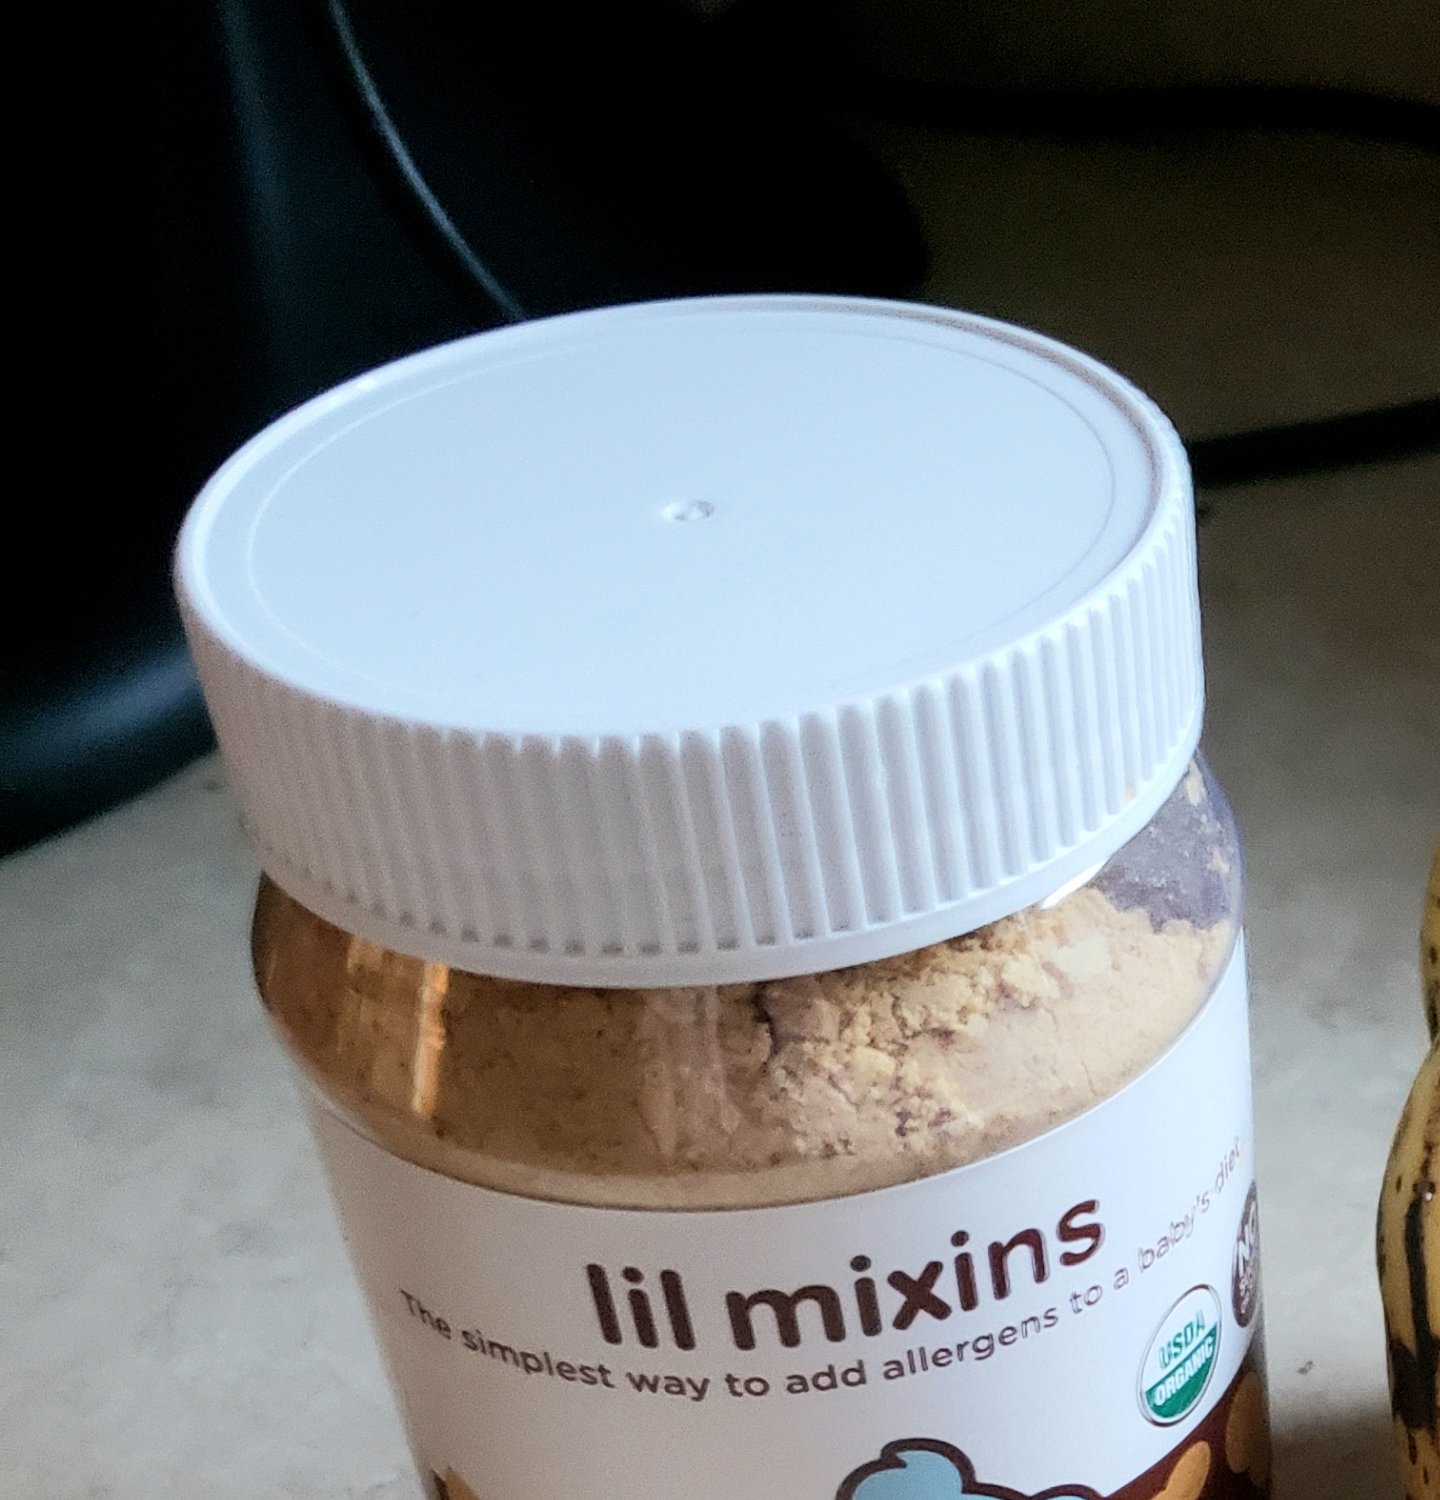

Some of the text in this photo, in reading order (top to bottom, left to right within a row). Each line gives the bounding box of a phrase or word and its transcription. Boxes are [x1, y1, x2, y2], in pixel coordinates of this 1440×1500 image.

[400, 1289, 452, 1340] The
[461, 1328, 615, 1388] simplest
[626, 1371, 710, 1402] way
[725, 1372, 770, 1398] to
[786, 1359, 868, 1395] add
[883, 1305, 1059, 1381] allergens
[1069, 1284, 1104, 1314] to
[1113, 1267, 1129, 1291] a
[1137, 1190, 1211, 1274] baby's
[586, 1199, 1105, 1351] lil mixins
[1153, 1335, 1216, 1406] ORGANIC
[1159, 1308, 1206, 1370] USDA
